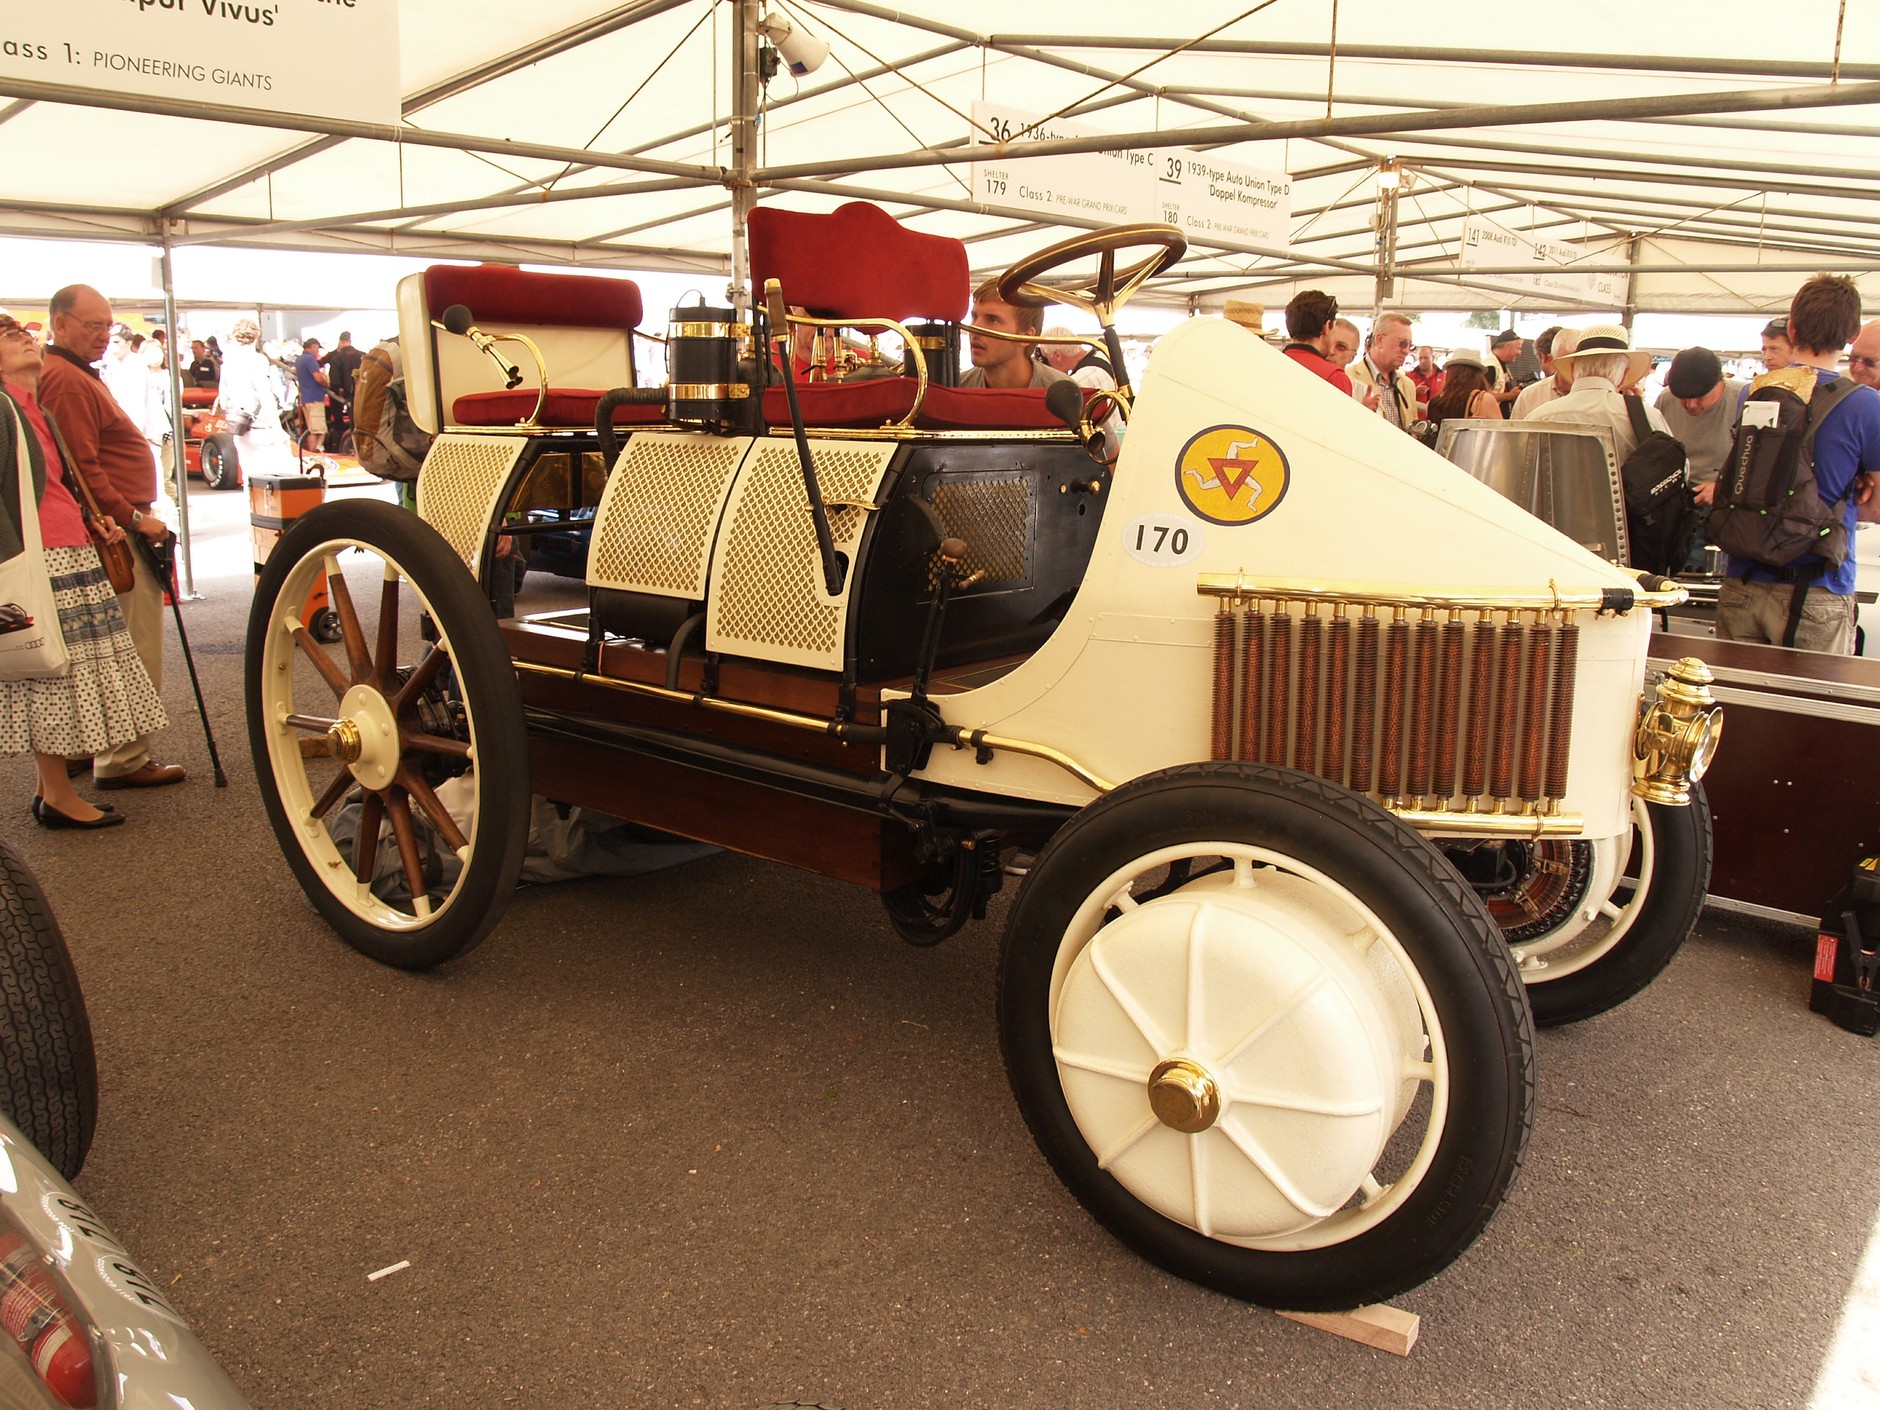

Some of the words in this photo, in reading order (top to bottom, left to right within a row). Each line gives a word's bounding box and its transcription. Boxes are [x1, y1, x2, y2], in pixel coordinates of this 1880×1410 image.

[202, 0, 279, 26] Vivus'
[63, 43, 81, 65] 1:
[93, 51, 206, 82] PIONEERING
[212, 68, 272, 91] GIANTS
[990, 117, 1011, 140] 36
[1126, 149, 1144, 166] Type
[1147, 153, 1154, 166] C
[1166, 157, 1182, 179] 39
[983, 169, 1009, 180] SHELTER
[1187, 161, 1225, 182] 1939-type
[1226, 171, 1243, 185] Auto
[1245, 176, 1265, 191] Union
[1267, 180, 1282, 196] Type
[1284, 184, 1290, 196] D
[986, 179, 1007, 195] 179
[1019, 185, 1043, 201] Class
[1056, 194, 1080, 207] PRE-WAR
[1082, 199, 1101, 211] GRAND
[1102, 202, 1114, 212] PRIX
[1114, 204, 1128, 215] CARS
[1163, 210, 1178, 224] 180
[1186, 215, 1205, 229] Class
[1468, 227, 1480, 243] 141
[1733, 434, 1754, 495] Quechua
[1135, 524, 1189, 555] 170
